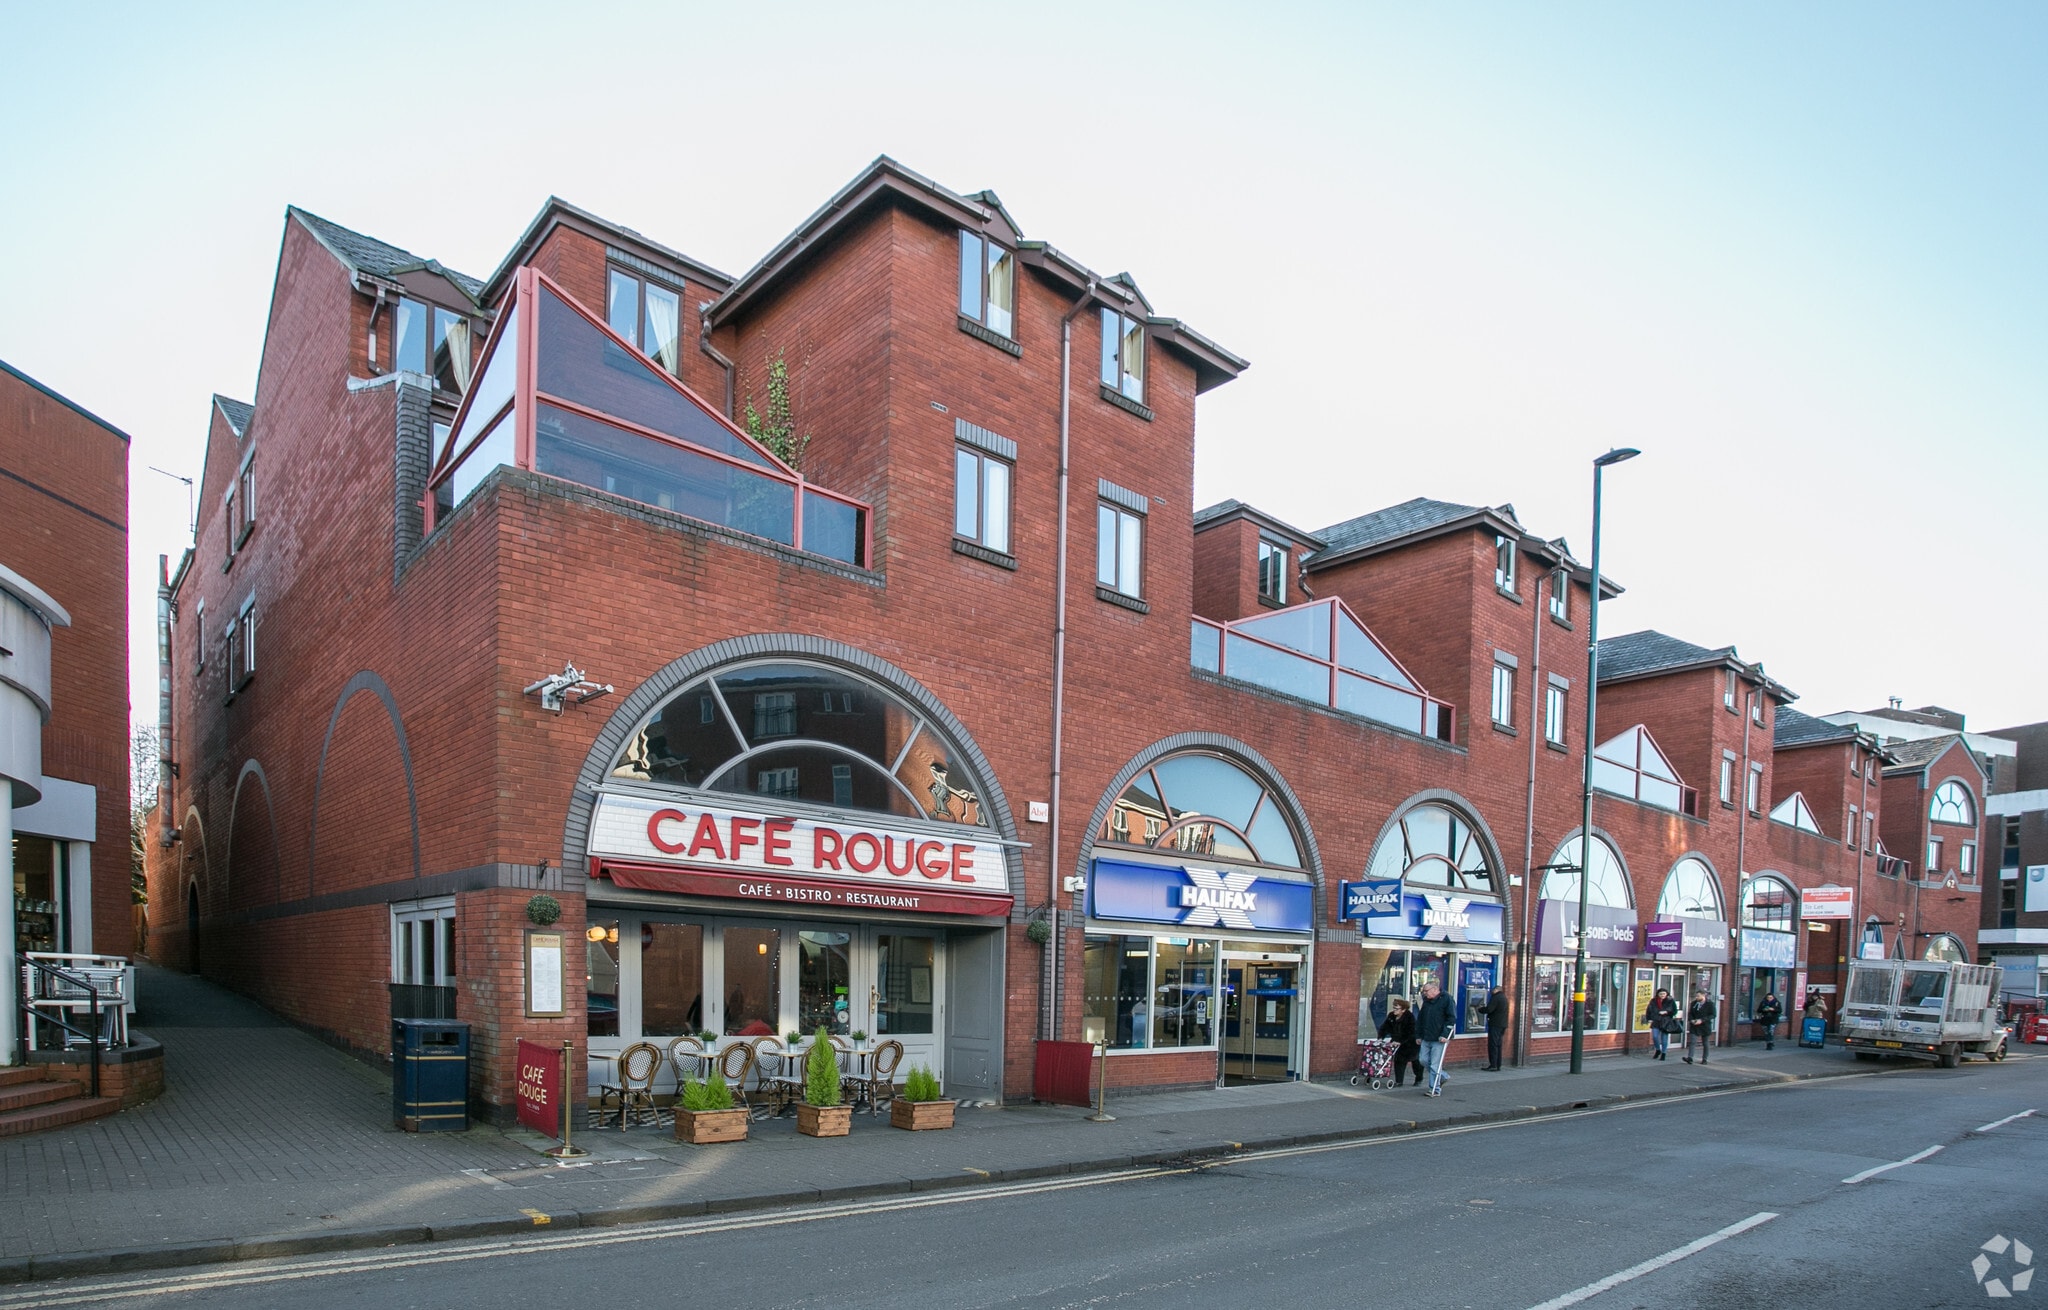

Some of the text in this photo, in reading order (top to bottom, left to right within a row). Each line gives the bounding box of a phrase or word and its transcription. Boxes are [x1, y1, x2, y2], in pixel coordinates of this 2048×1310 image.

[1031, 806, 1048, 817] Abel
[647, 808, 976, 883] CAFÉ ROUGE
[1946, 879, 1955, 889] 62
[738, 883, 920, 908] CAFÉ BISTRO RESTAURANT
[1182, 885, 1257, 911] HALIFAX
[1349, 893, 1398, 906] HALIFAX
[1423, 908, 1470, 928] HALIFAX
[1613, 925, 1634, 942] beds
[1683, 934, 1707, 948] ensons
[1709, 934, 1725, 949] beds
[1637, 984, 1651, 996] FREE
[522, 1064, 546, 1085] CAFÉ
[518, 1080, 547, 1105] ROUGE
